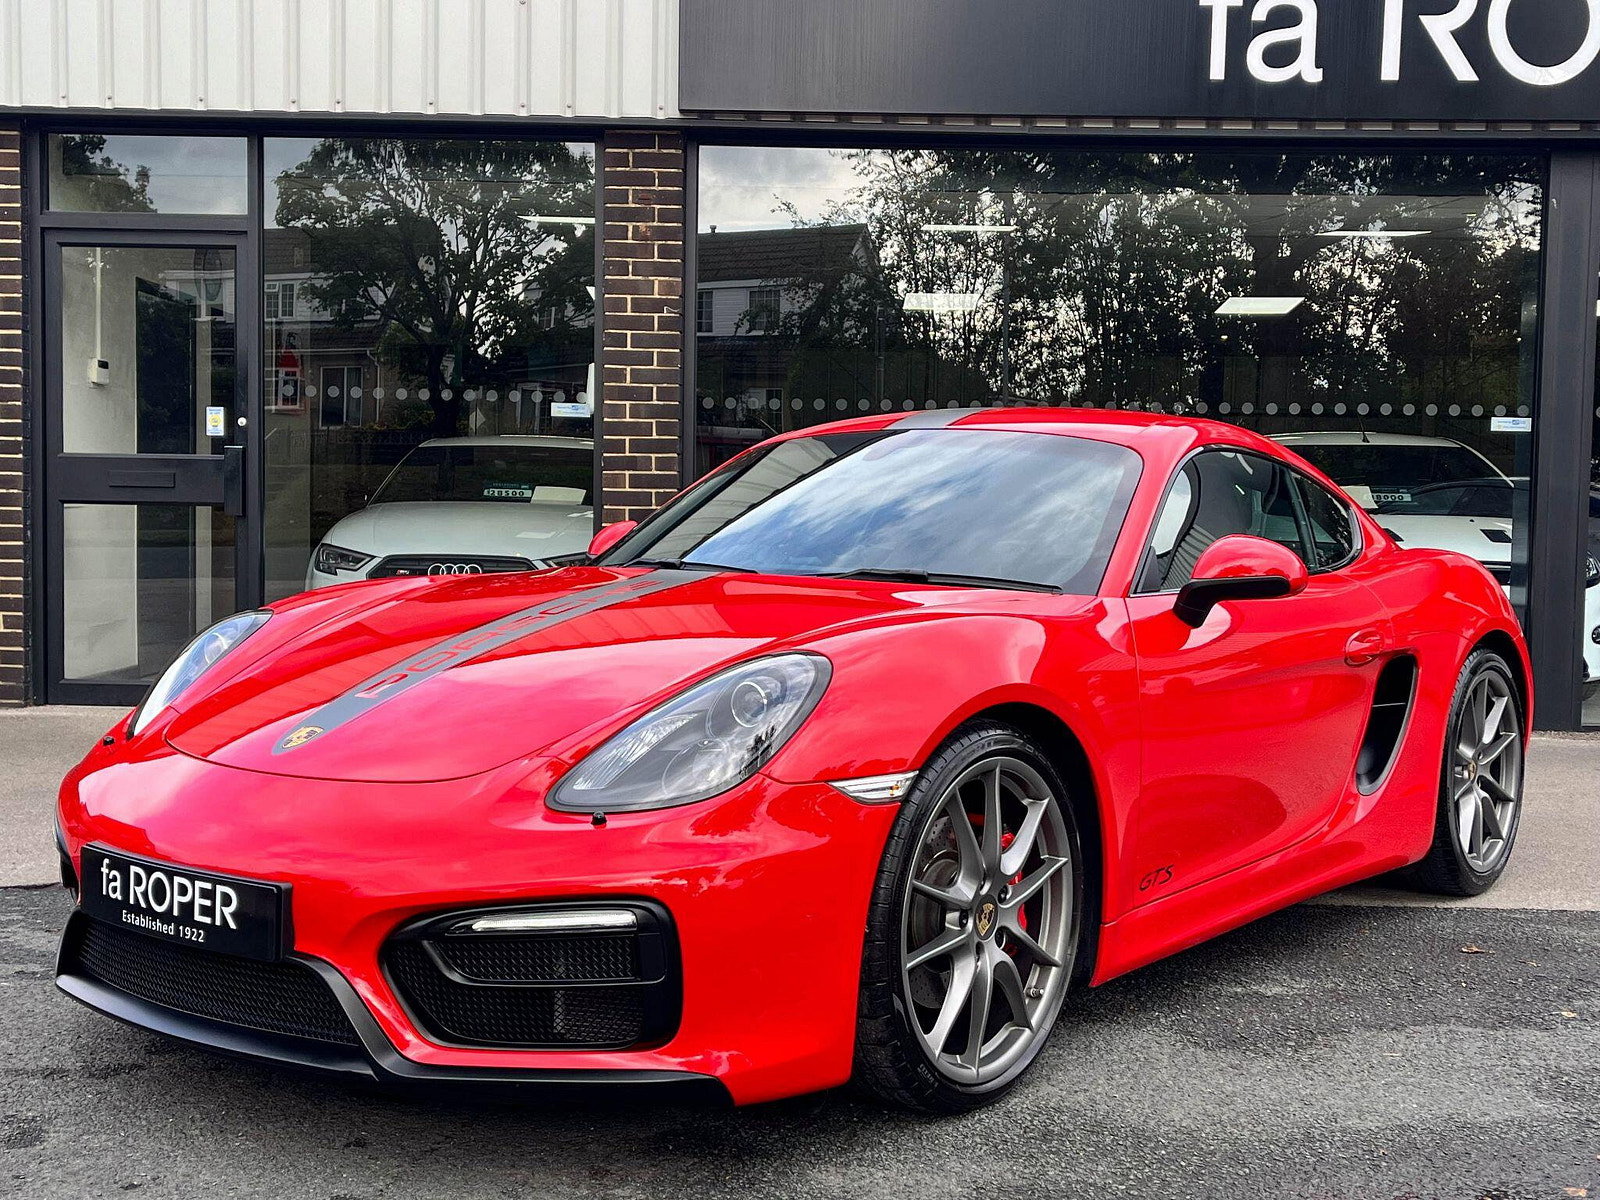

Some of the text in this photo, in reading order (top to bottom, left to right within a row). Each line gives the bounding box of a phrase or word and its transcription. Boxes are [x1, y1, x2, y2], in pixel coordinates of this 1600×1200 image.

[1199, 0, 1323, 83] fa
[101, 858, 238, 930] fa ROPER
[1139, 864, 1175, 892] GTS
[122, 909, 205, 943] Established 1922
